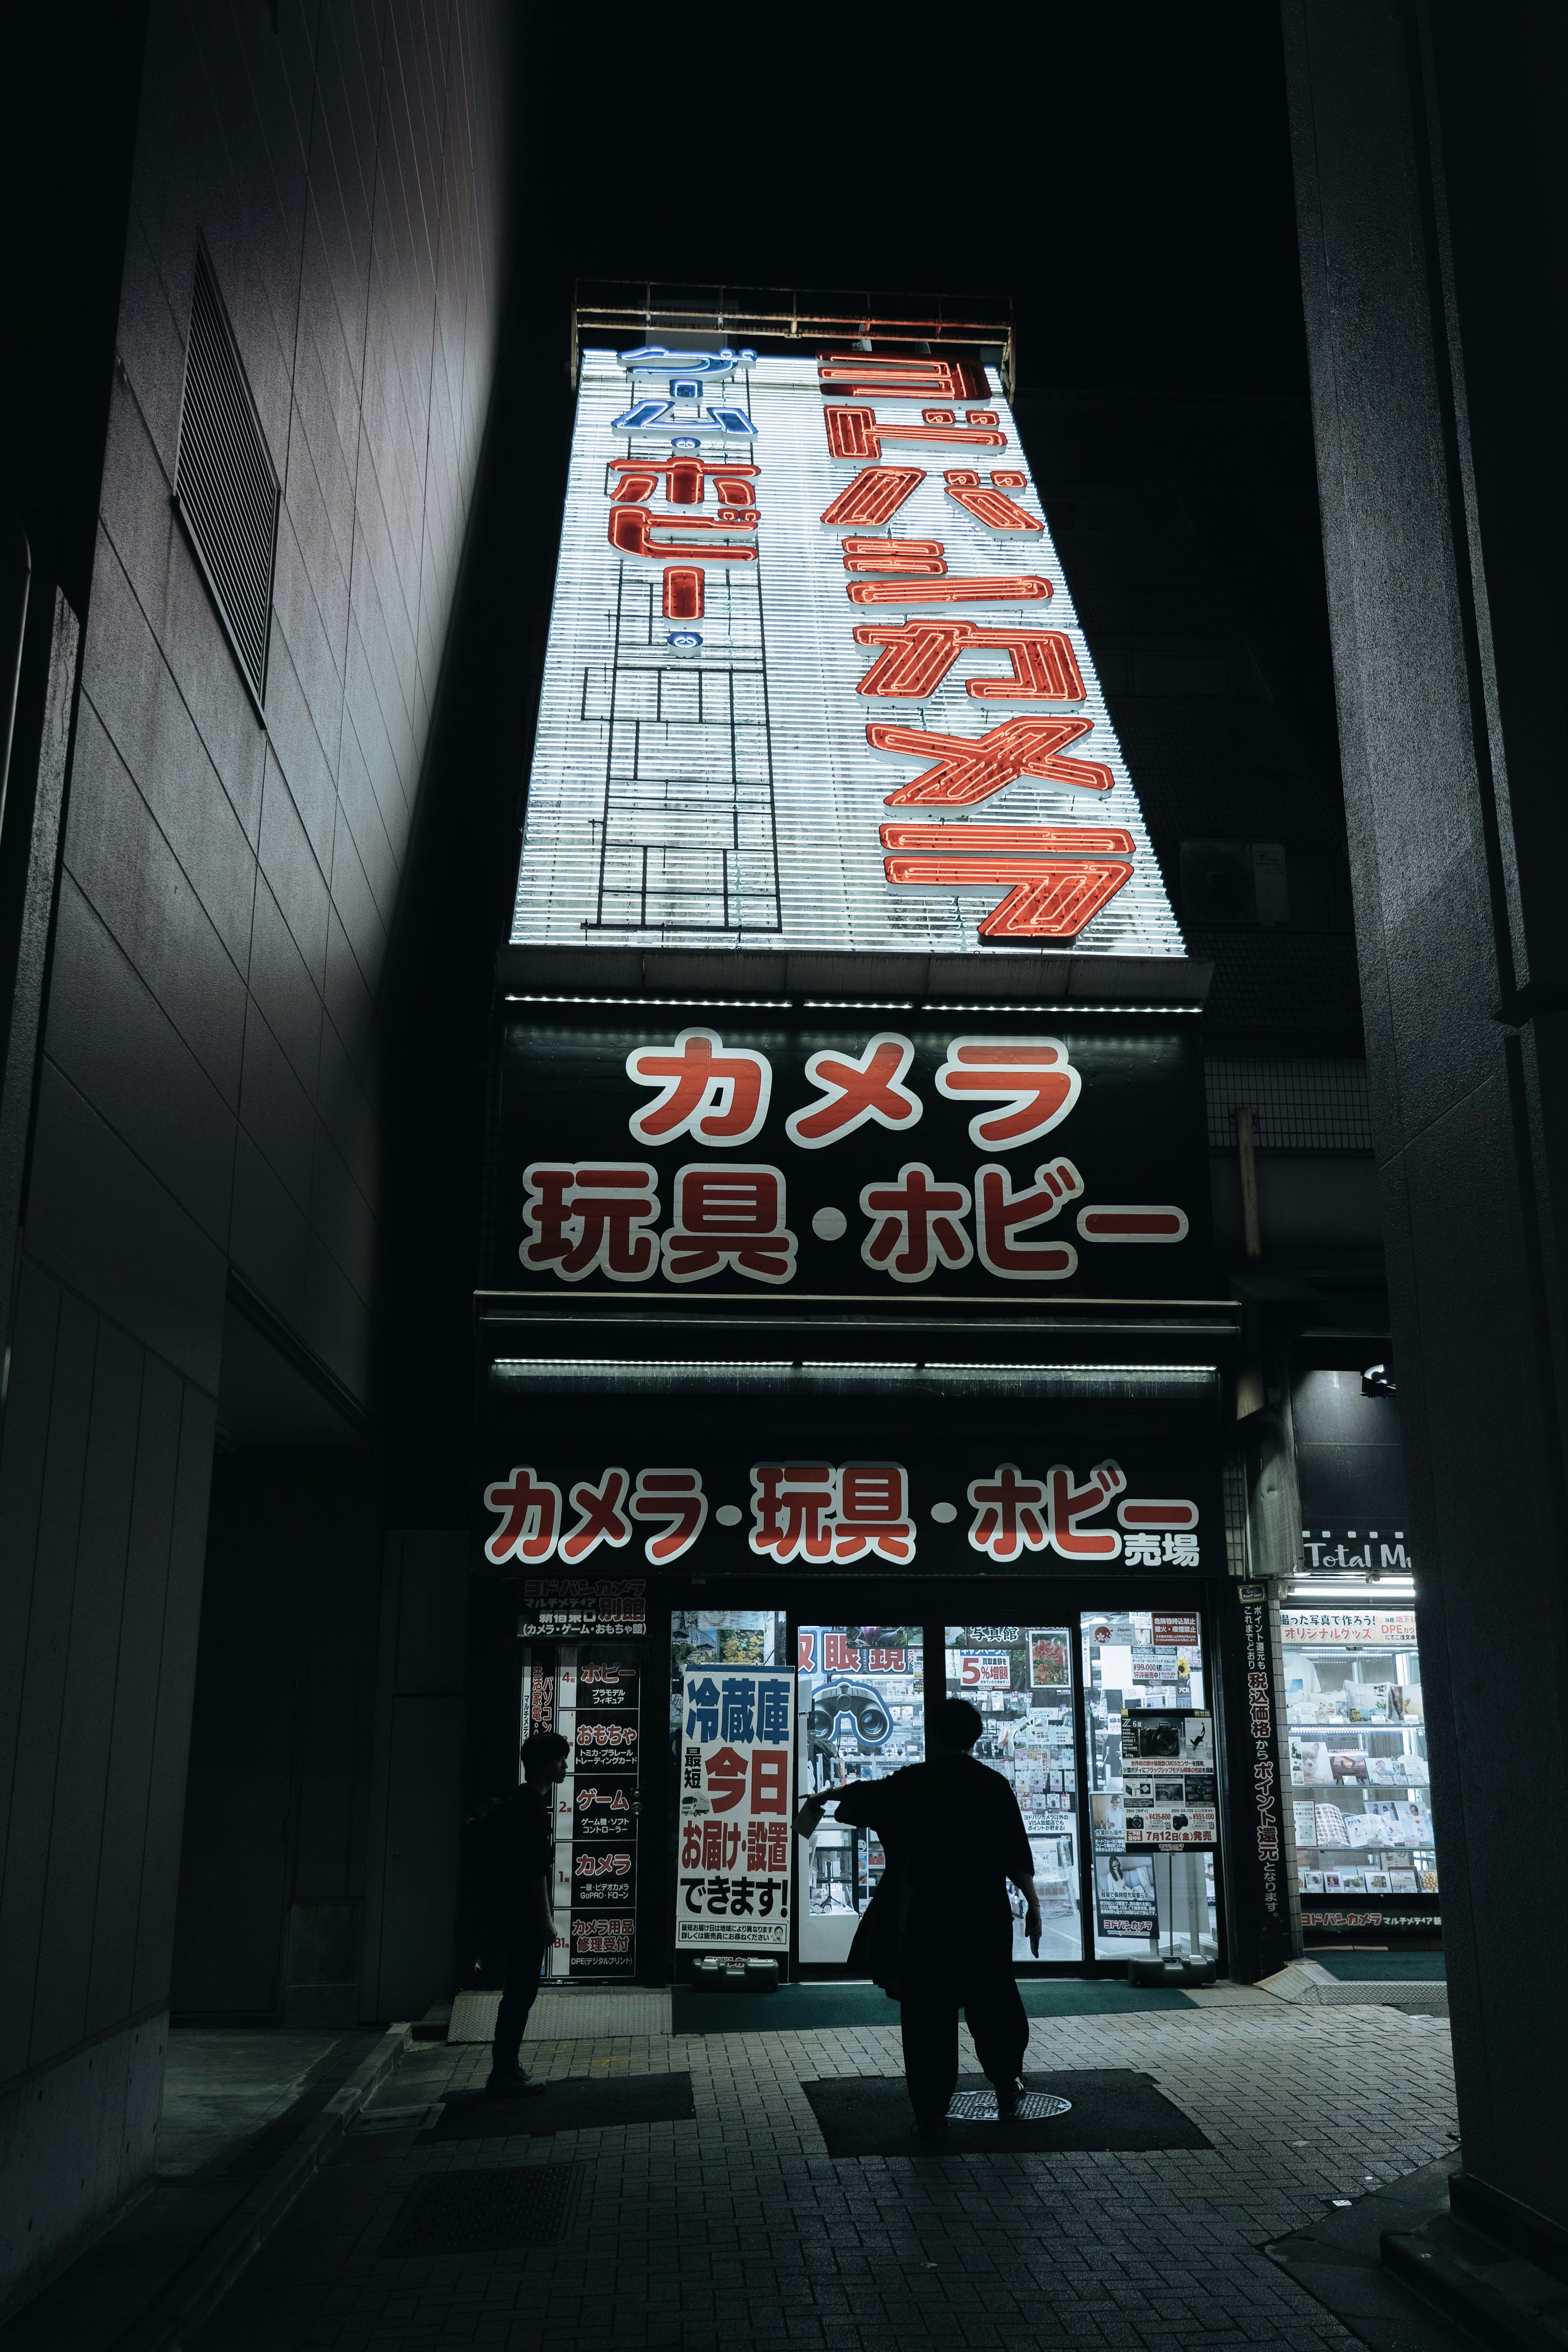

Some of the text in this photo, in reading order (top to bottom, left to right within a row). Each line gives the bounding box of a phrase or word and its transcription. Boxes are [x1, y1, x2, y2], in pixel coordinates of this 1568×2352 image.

[815, 349, 1136, 947] ヨドバシカメラ
[626, 1027, 1082, 1152] カメラ
[519, 1156, 1189, 1284] 玩具・ホビー
[1124, 1534, 1200, 1568] 売場
[1303, 1543, 1371, 1568] Total
[524, 1580, 646, 1596] ヨドバシカメラ
[524, 1598, 596, 1608] マルチメディア
[599, 1597, 646, 1622] 別館
[539, 1610, 596, 1623] 新宿東口
[523, 1623, 646, 1635] (カメラ・ゲーム・おもちゃ館)
[970, 1627, 1019, 1642] 写真館
[1244, 1606, 1255, 1670] これまでどおり
[1254, 1606, 1265, 1670] ポイント還元も
[1285, 1627, 1372, 1640] オリジナルグッズ
[581, 1662, 636, 1683] ホビー
[542, 1676, 553, 1733] パソコン
[686, 1677, 791, 1745] 冷蔵庫
[577, 1724, 637, 1746] おもちゃ
[684, 1747, 702, 1789] 最短
[705, 1747, 788, 1815] 今日
[577, 1788, 630, 1811] ゲーム
[581, 1818, 630, 1826] ゲーム機・ソフト
[583, 1826, 628, 1834] コントローラー
[682, 1820, 788, 1872] お届け・設置
[1146, 1831, 1212, 1841] 7月12日(金)発売
[575, 1854, 631, 1876] カメラ
[680, 1875, 788, 1918] できます!
[572, 1919, 635, 1936] カメラ用品
[682, 1924, 773, 1933] 最短お届け日は地域により異なります
[1104, 1920, 1152, 1930] ヨドバシカメラ
[1301, 1913, 1381, 1926] ヨドバシカメラ
[576, 1936, 630, 1953] 修理受付
[681, 1933, 769, 1941] 詳しくは販売員にお尋ねください
[571, 1957, 633, 1965] DPE(デジタルプリント)
